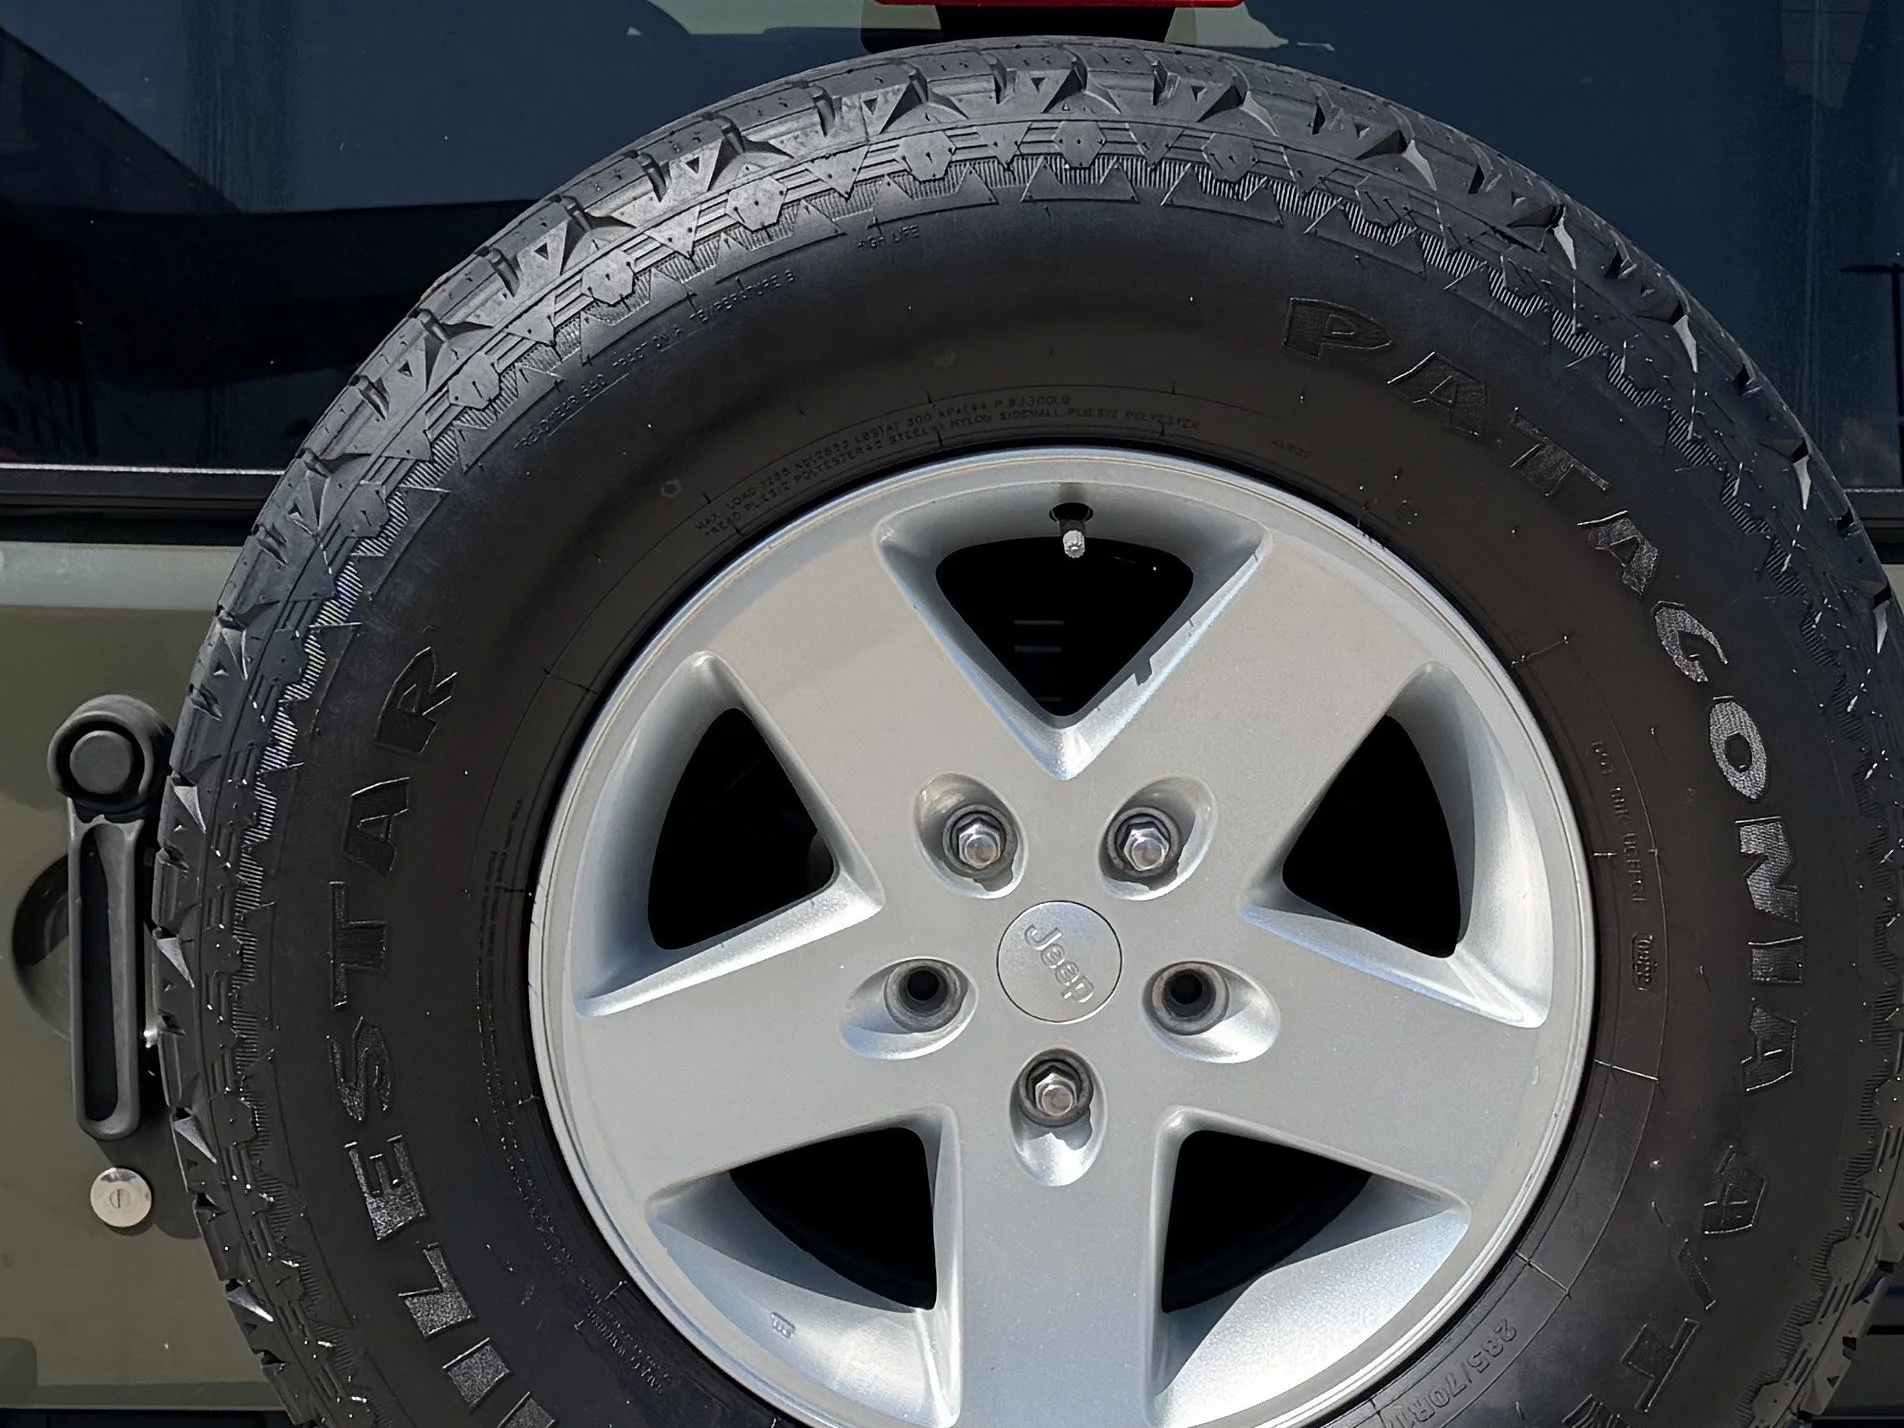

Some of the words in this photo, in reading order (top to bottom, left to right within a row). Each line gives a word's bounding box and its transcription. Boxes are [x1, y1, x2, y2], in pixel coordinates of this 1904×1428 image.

[1282, 297, 1804, 1094] PATAGONIA
[1024, 924, 1095, 1004] Jeep
[1620, 1139, 1768, 1413] A/T
